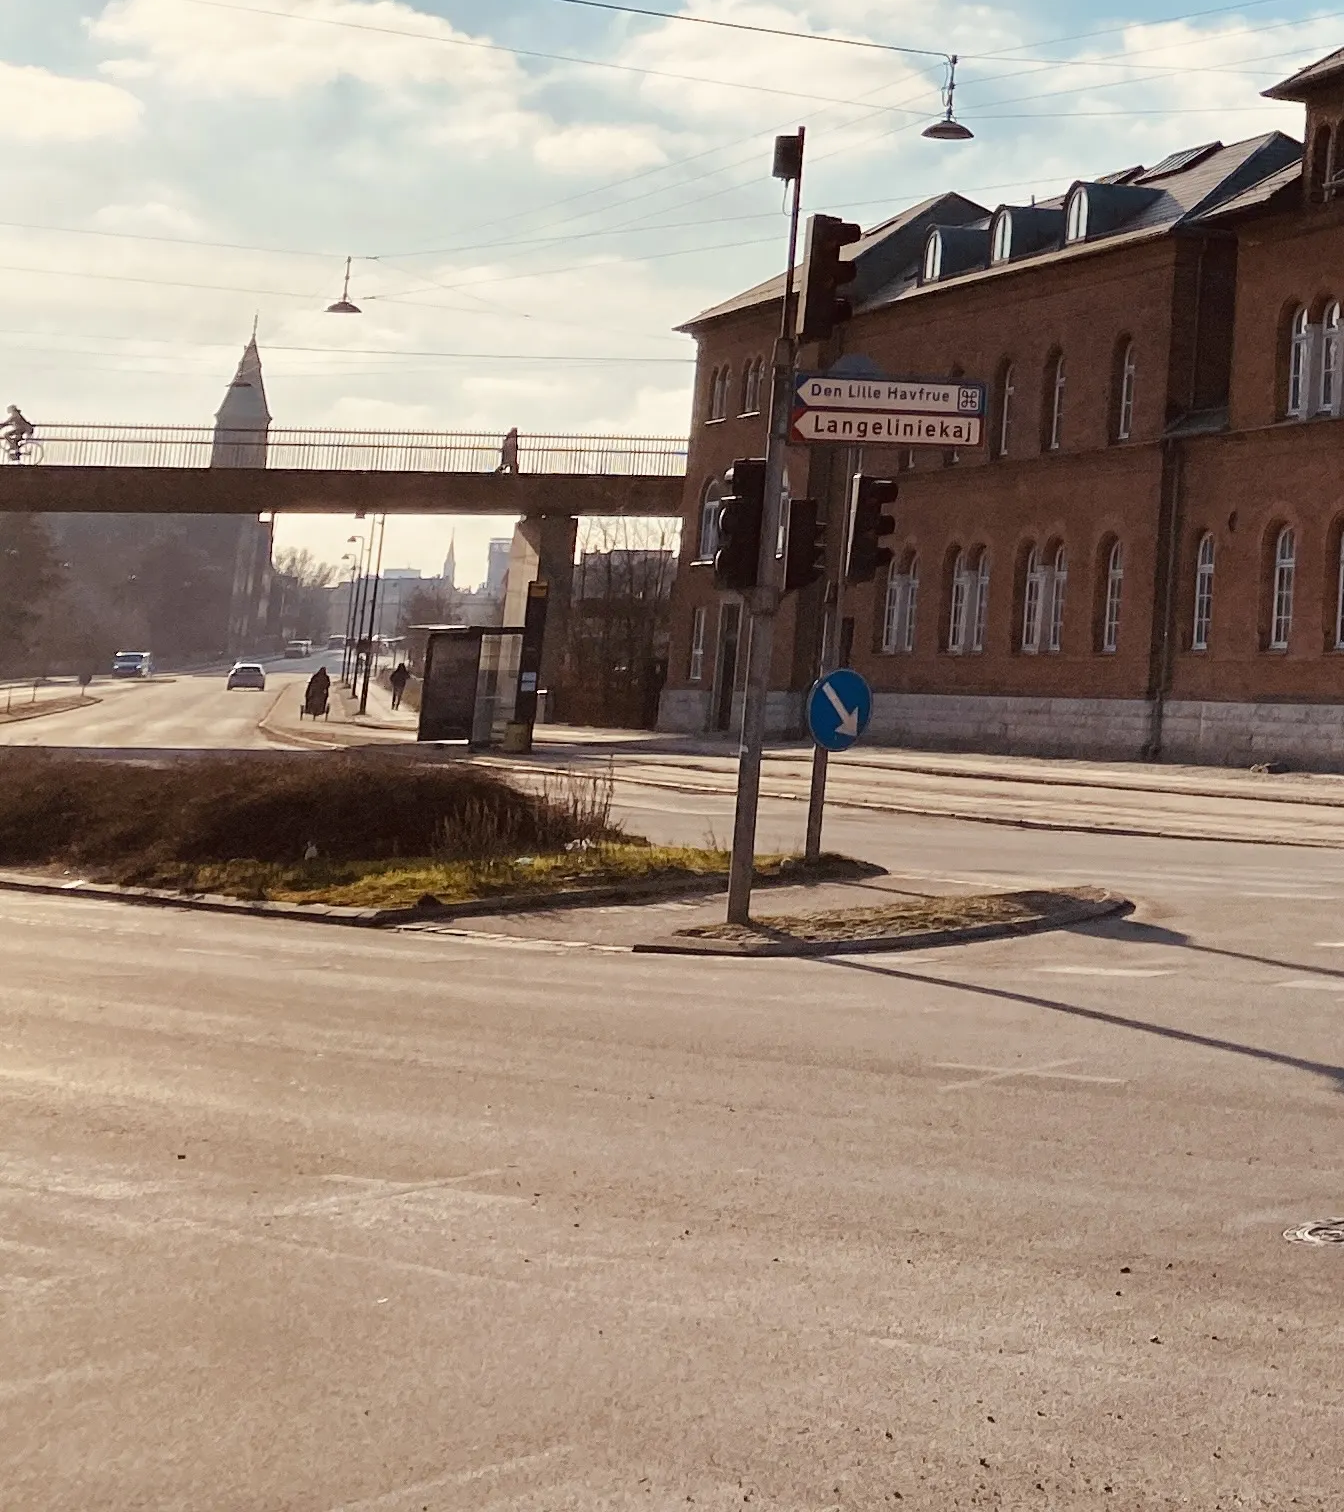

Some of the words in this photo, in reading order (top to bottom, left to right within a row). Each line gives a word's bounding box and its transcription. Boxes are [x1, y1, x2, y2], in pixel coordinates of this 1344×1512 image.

[811, 383, 842, 398] Den
[848, 384, 881, 399] Lille
[887, 386, 950, 403] Havfrue
[813, 414, 972, 443] Langeliniekaj
